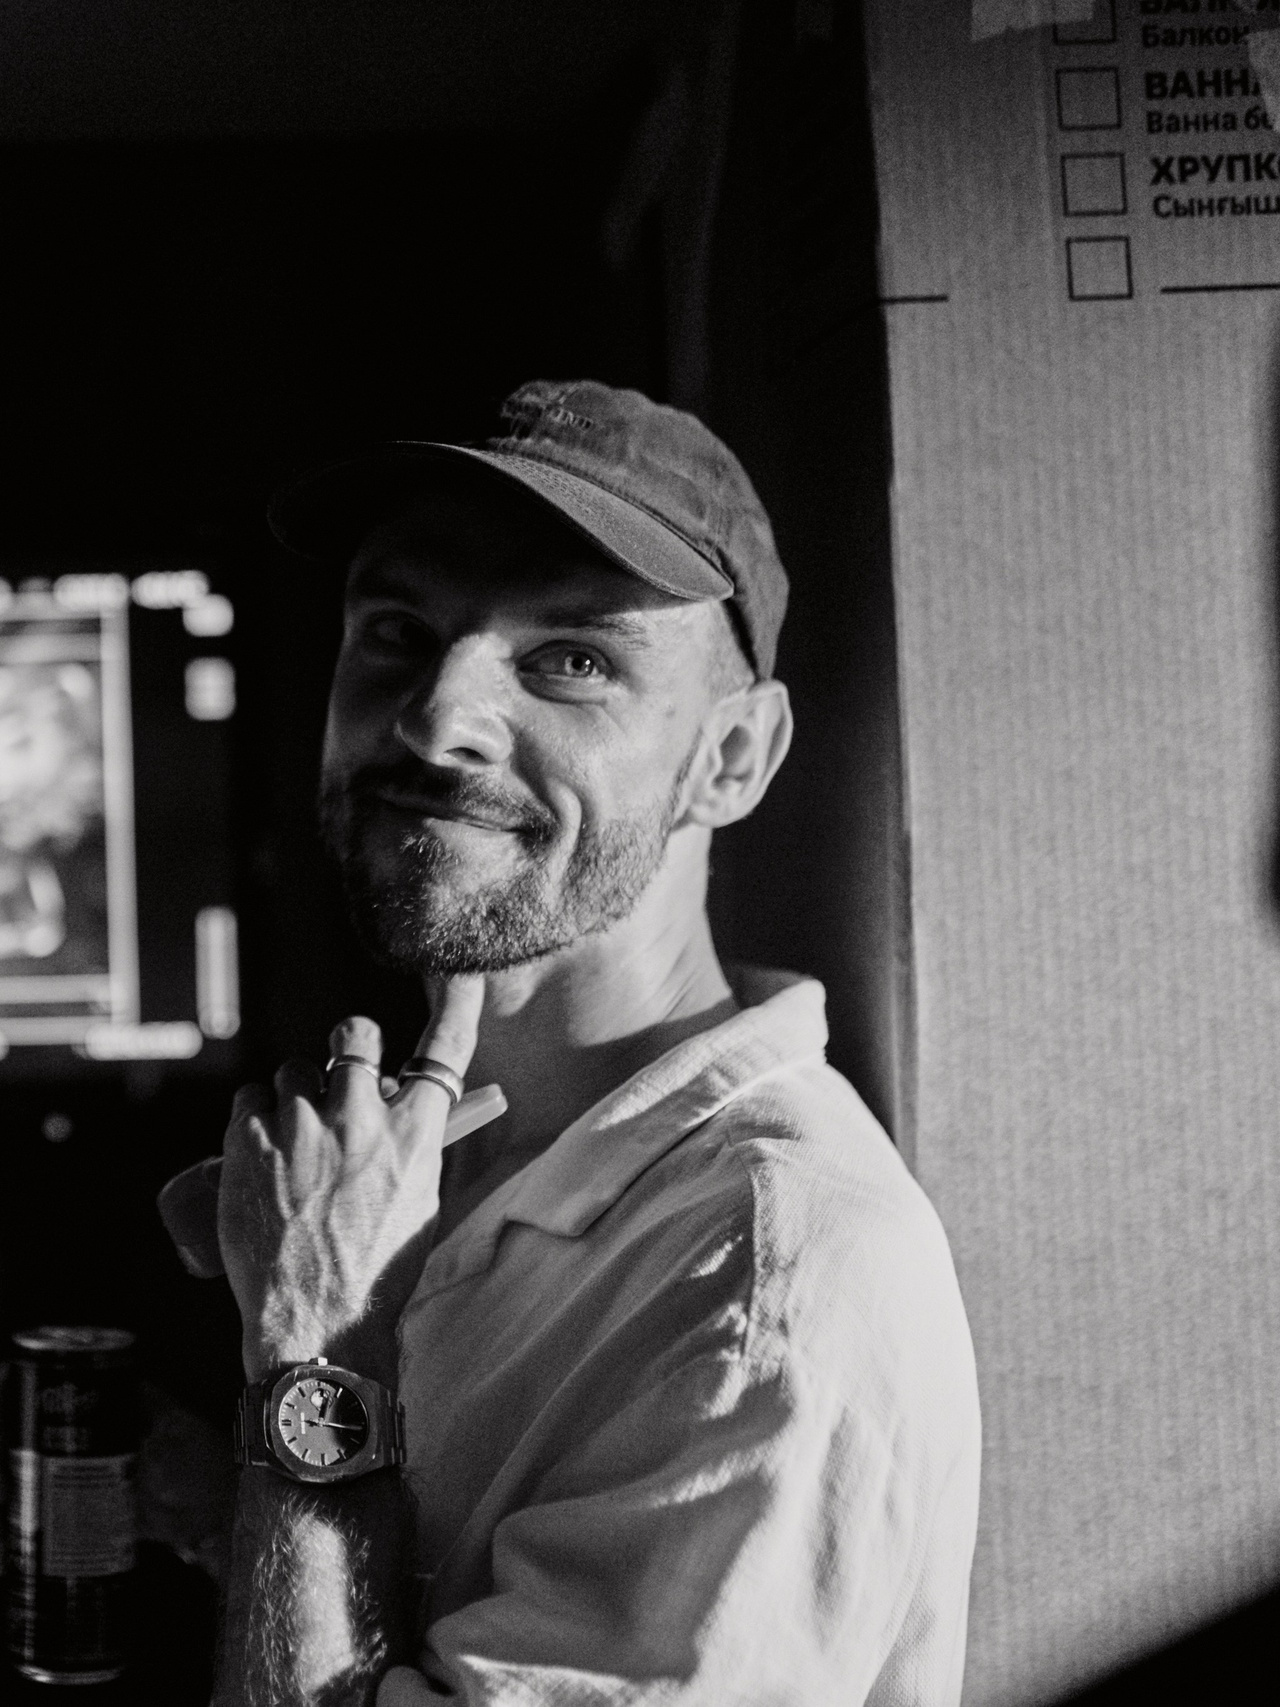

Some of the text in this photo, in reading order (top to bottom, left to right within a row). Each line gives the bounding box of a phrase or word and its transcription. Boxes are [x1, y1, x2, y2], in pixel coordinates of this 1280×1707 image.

[1145, 69, 1261, 100] ВАНН
[1146, 111, 1238, 134] Ванна
[1151, 152, 1280, 186] ХРУПК
